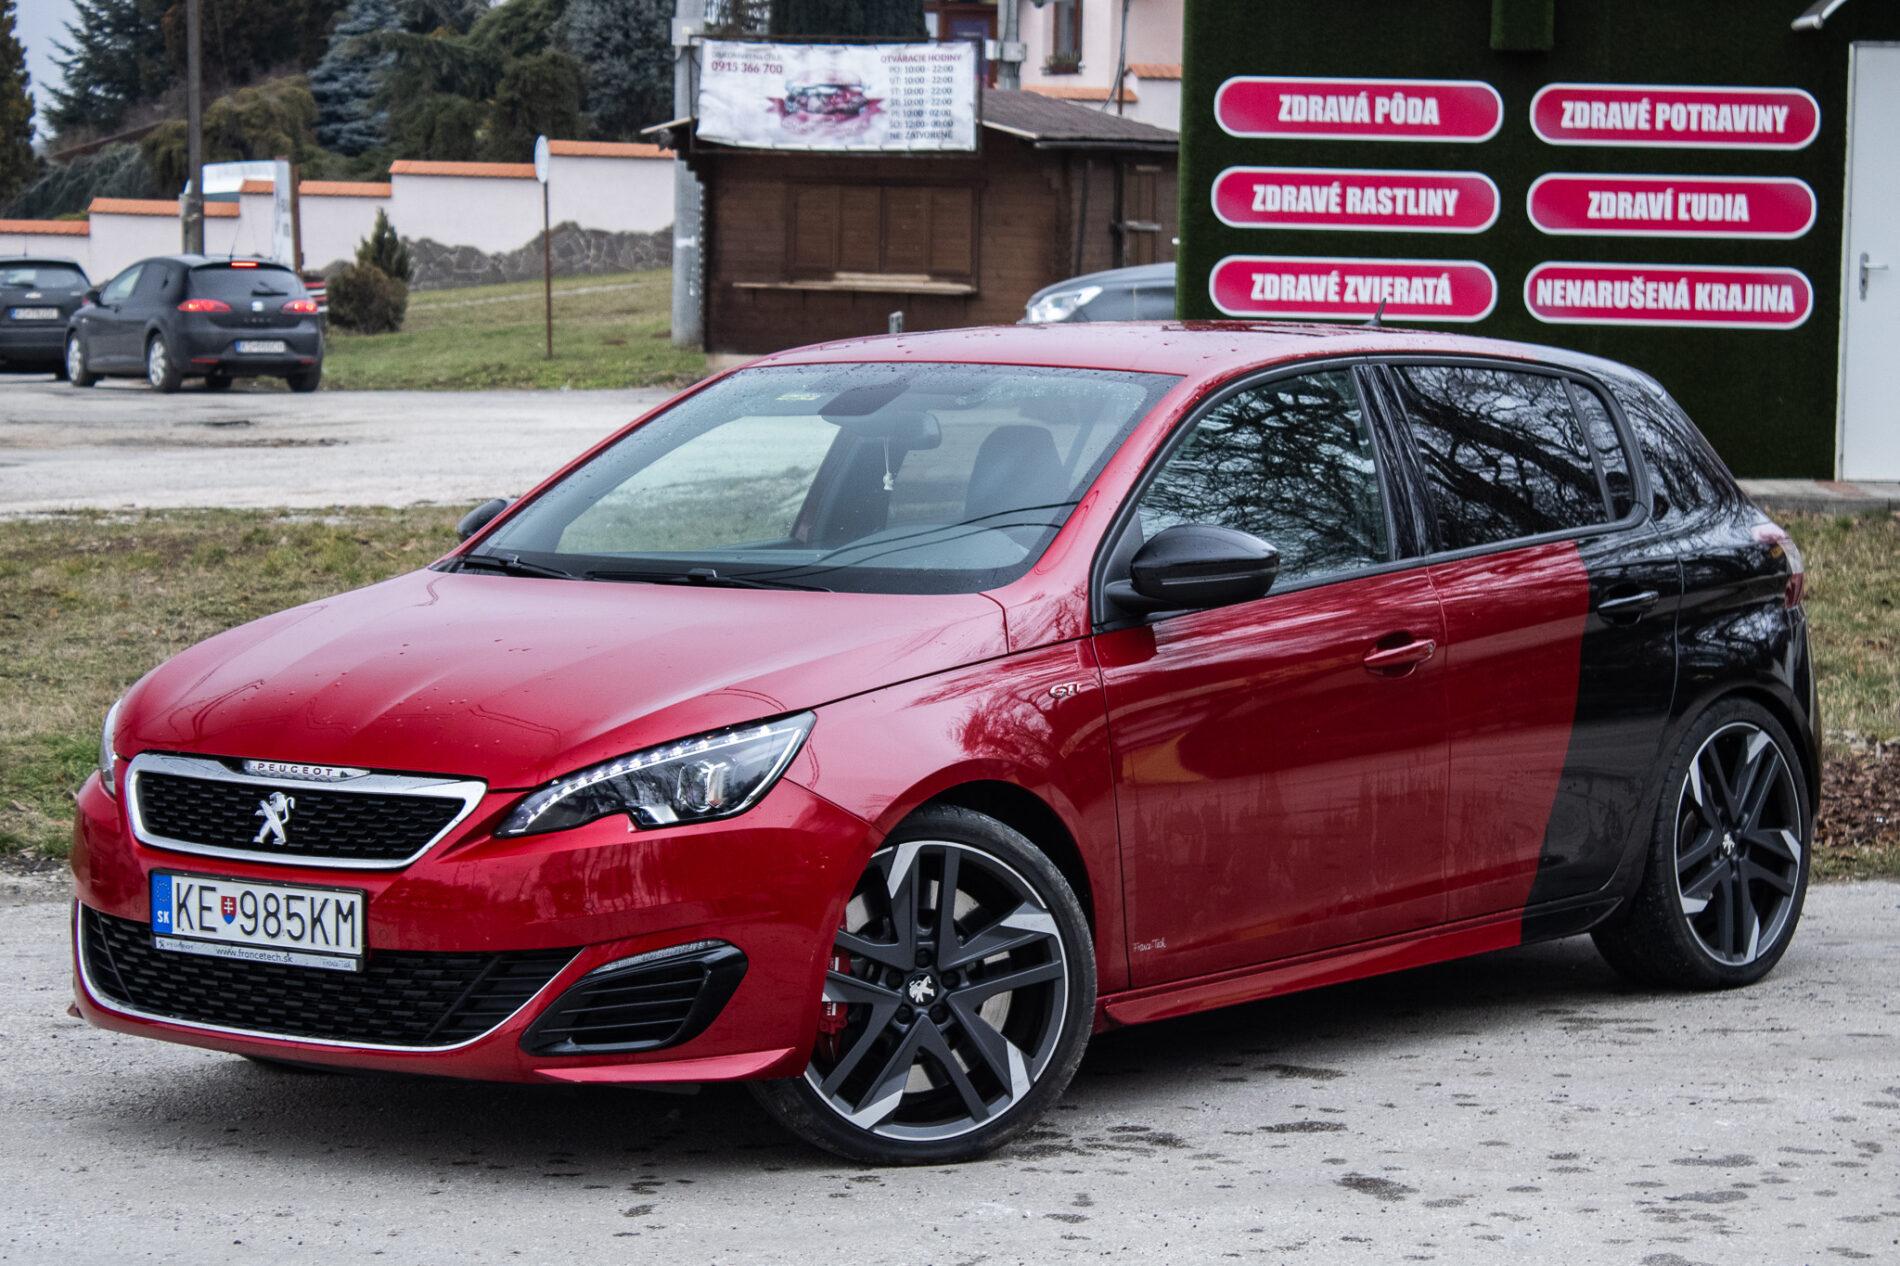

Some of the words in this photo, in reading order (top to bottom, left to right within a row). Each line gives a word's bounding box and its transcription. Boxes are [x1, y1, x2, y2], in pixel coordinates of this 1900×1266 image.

[763, 63, 783, 74] 700
[1278, 91, 1371, 124] ZDRAVÁ
[1375, 91, 1440, 125] PÔDA
[1561, 97, 1652, 130] ZDRAVÉ
[1655, 103, 1789, 133] POTRAVINY
[1252, 181, 1343, 214] ZDRAVÉ
[1346, 186, 1459, 216] RASTLINY
[1587, 187, 1675, 220] ZDRAVÍ
[1677, 192, 1750, 222] ĽUDIA
[1250, 270, 1341, 302] ZDRAVÉ
[1344, 272, 1453, 305] ZVIERATÁ
[1536, 275, 1691, 310] NENARUŠENÁ
[1695, 283, 1795, 313] KRAJINA
[257, 762, 333, 776] PEUGEOT
[156, 909, 170, 924] SK
[175, 882, 218, 933] KE
[239, 890, 356, 948] 985KM
[215, 947, 294, 964] www.francetech.sk
